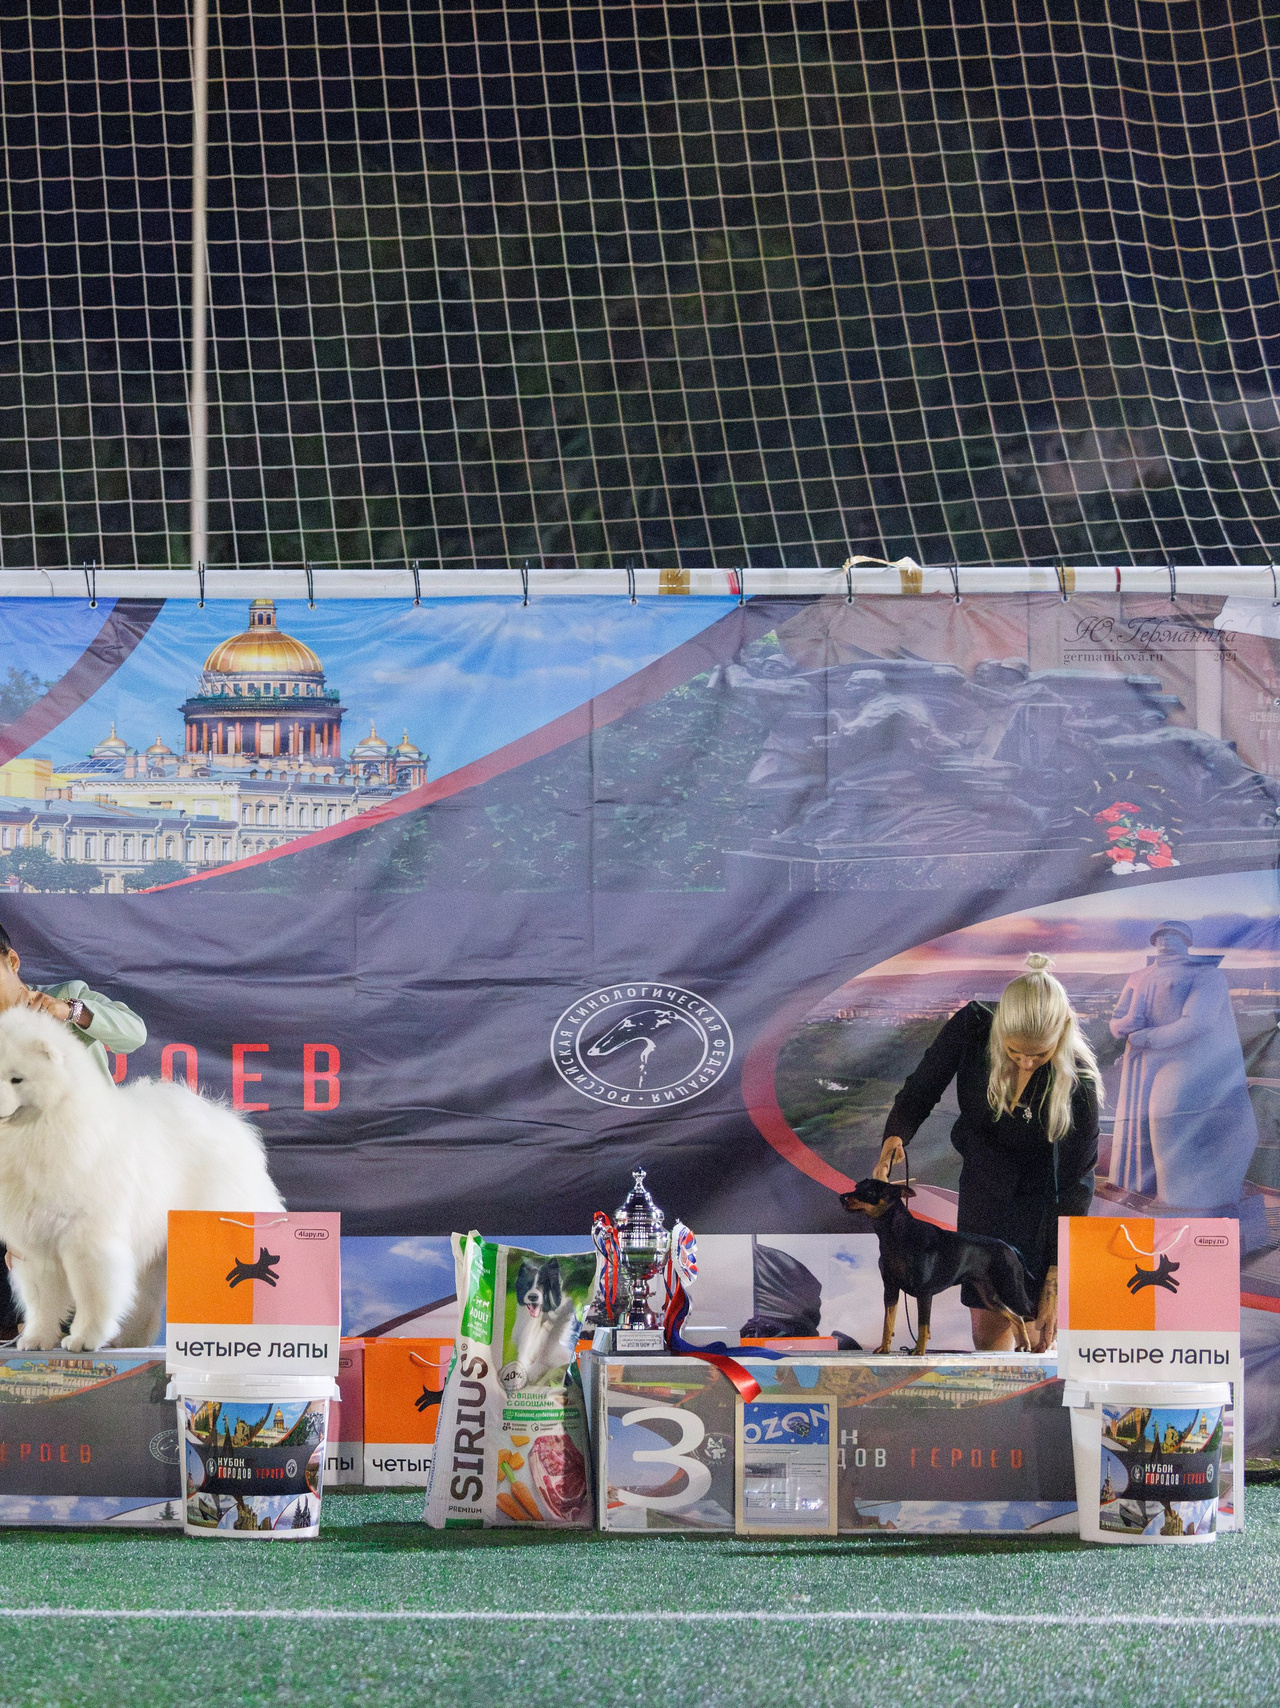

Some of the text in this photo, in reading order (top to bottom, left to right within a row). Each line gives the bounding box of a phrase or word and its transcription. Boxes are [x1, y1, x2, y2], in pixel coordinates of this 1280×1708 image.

[558, 987, 726, 1103] РОССИЙСКАЯ КИНОЛОГИЧЕСКАЯ ФЕДЕРАЦИЯ
[297, 1230, 325, 1239] 4lapy.ru
[450, 1355, 489, 1502] SIRIUS
[622, 1406, 712, 1509] 3
[372, 1458, 432, 1472] четыр
[448, 1505, 482, 1514] PREMIUM
